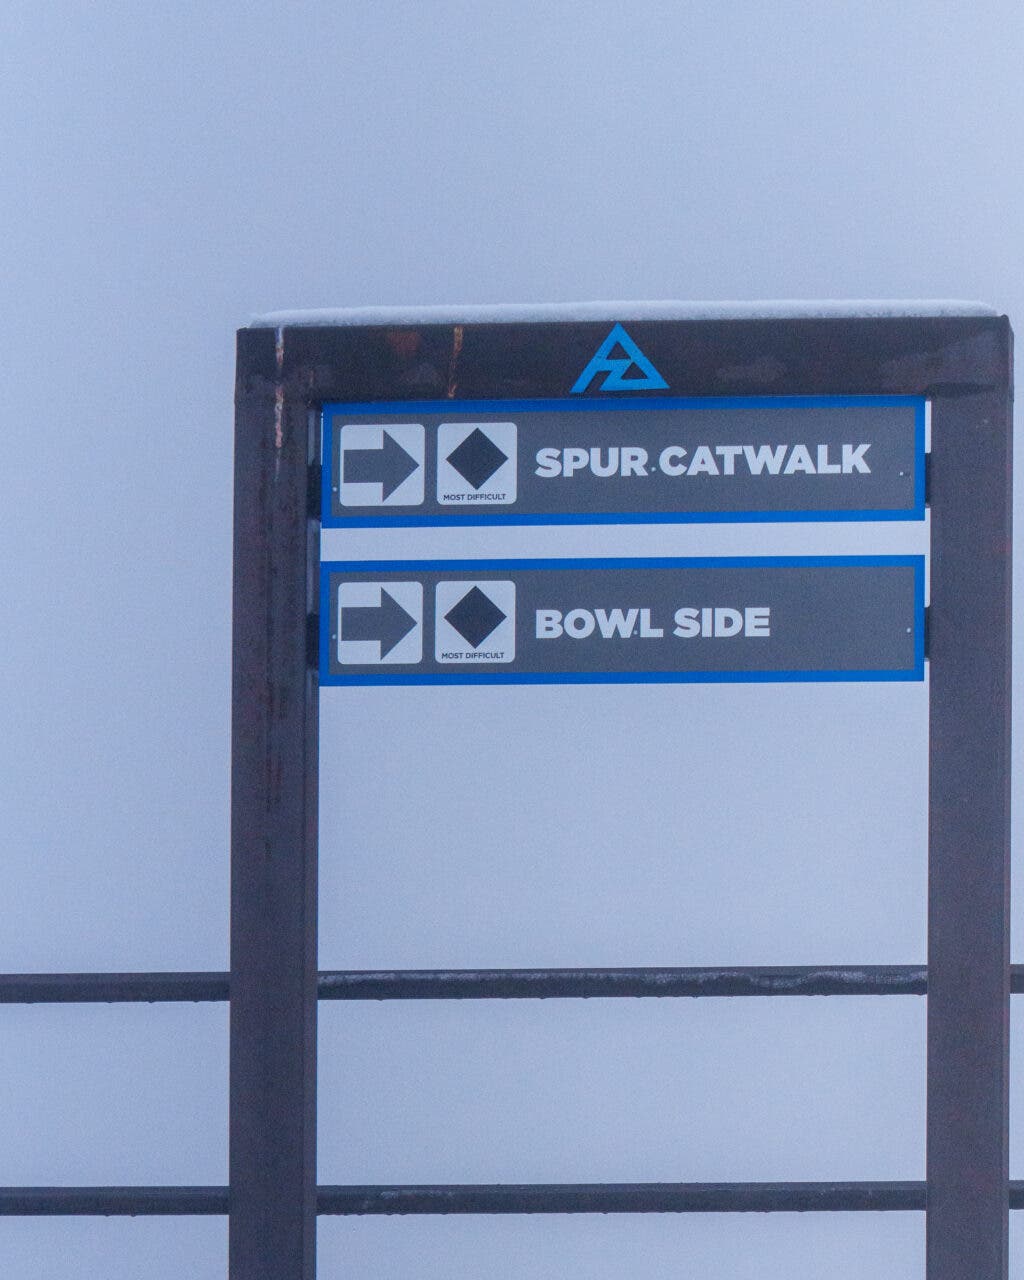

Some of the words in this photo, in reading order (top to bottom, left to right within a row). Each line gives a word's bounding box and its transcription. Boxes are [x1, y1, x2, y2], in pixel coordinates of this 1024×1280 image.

[535, 447, 650, 479] SPUR
[660, 444, 873, 478] CATWALK
[443, 493, 466, 501] MOST
[466, 493, 506, 501] DIFFICULT
[535, 609, 665, 641] BOWL
[674, 608, 772, 640] SIDE
[441, 652, 464, 660] MOST
[465, 652, 505, 660] DIFFICULT
